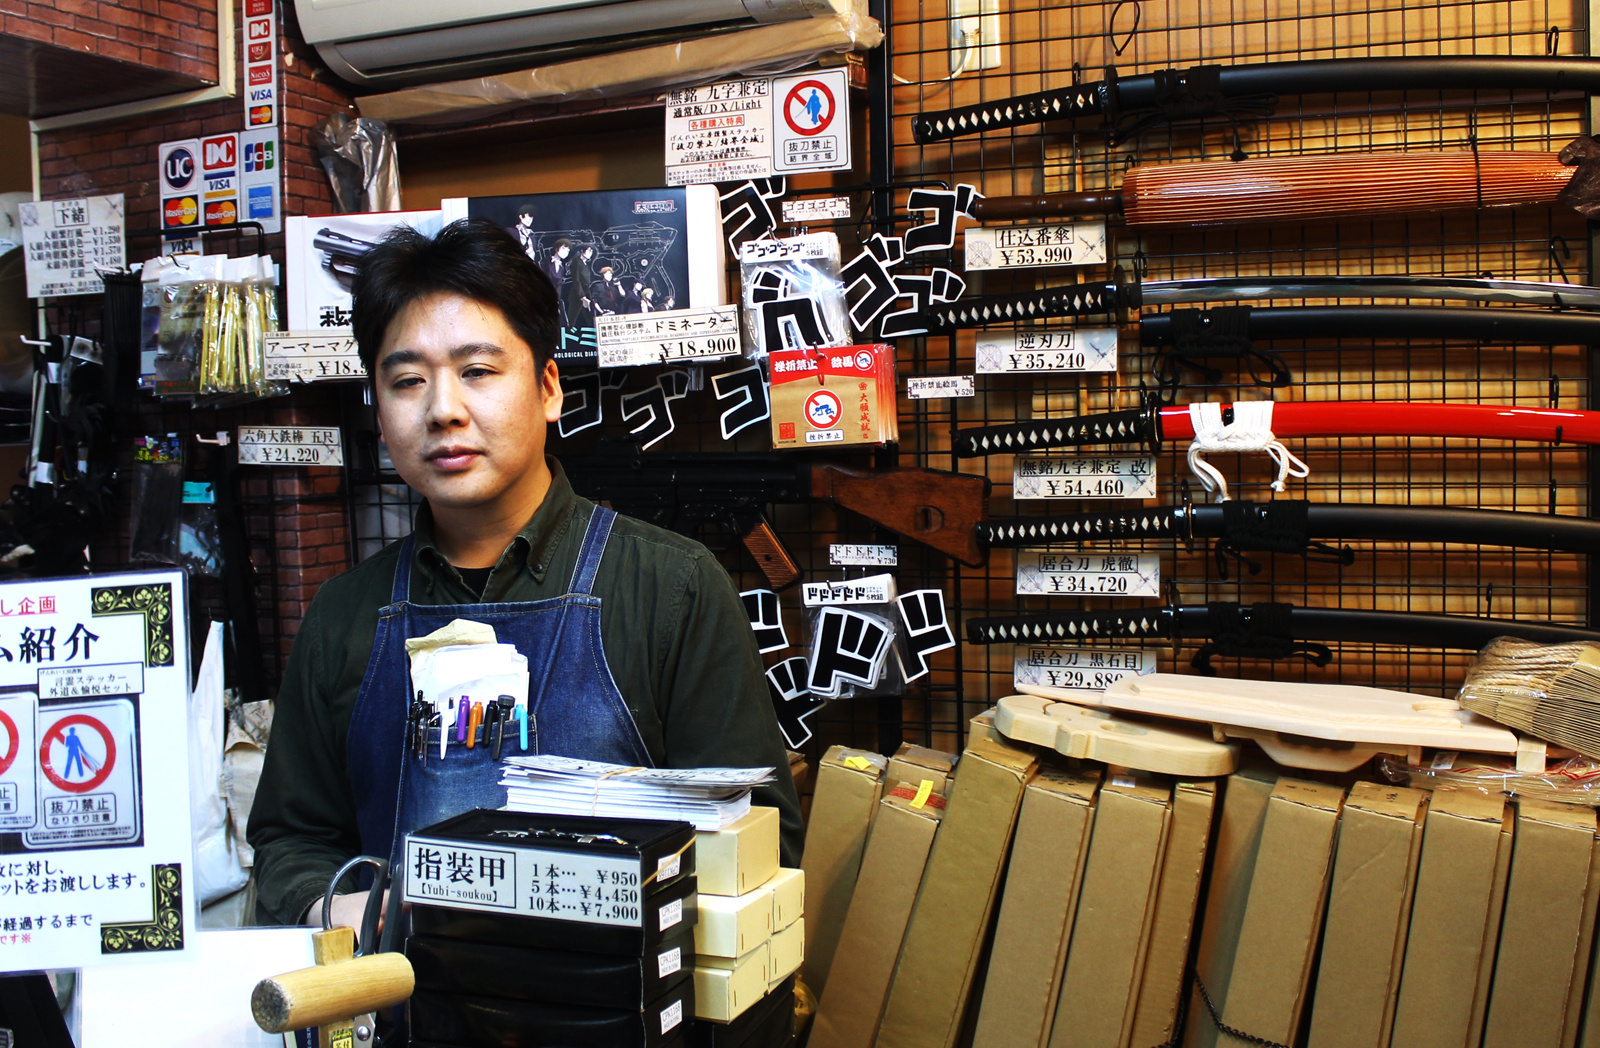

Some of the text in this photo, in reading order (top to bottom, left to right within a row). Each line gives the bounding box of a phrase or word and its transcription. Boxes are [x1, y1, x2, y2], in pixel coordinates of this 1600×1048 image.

[251, 21, 269, 37] DC
[250, 88, 272, 101] VISA
[670, 80, 766, 105] 無銘 九字兼定
[250, 111, 272, 119] MasterCard
[691, 116, 743, 130] 各種購入特典
[206, 140, 234, 166] DC
[789, 139, 832, 152] 抜刀禁止
[244, 149, 274, 163] JCB
[166, 156, 194, 179] UC
[209, 178, 231, 191] VISA
[57, 207, 85, 224] 下緒
[165, 206, 197, 219] MasterCard
[206, 209, 236, 221] MasterCard
[1000, 226, 1070, 246] 仕込番傘
[747, 242, 805, 257] ゴゴゴゴゴ
[1001, 246, 1073, 265] ¥53,990
[655, 316, 733, 333] ドミネーター
[660, 337, 736, 358] ¥18,900
[1019, 333, 1071, 349] 逆刃刀
[774, 358, 818, 373] 挫折禁止
[1009, 353, 1085, 370] ¥35,240
[912, 380, 957, 390] 挫折禁止絵馬
[955, 388, 974, 396] ¥520
[244, 430, 334, 444] 六角大鉄棒 五尺
[809, 432, 841, 441] 挫折禁止
[262, 448, 319, 463] ¥24,220
[1022, 459, 1147, 475] 無銘九字兼定 改
[1047, 480, 1124, 496] ¥54,460
[834, 545, 884, 556] ドドドドド
[1041, 556, 1135, 572] 居合刀 虎徹
[1050, 576, 1128, 594] ¥34,720
[808, 587, 866, 601] ドドドドド
[1030, 651, 1137, 668] 居合刀 黒石目
[55, 674, 127, 686] 言霊ステッカー
[51, 798, 110, 814] 抜刀禁止
[51, 813, 110, 825] なりきり注意
[415, 847, 505, 887] 指装甲
[597, 869, 637, 887] ¥950
[422, 882, 498, 903] 【Yubi-soukou】
[580, 885, 638, 904] ¥4,450
[581, 902, 638, 921] ¥7,900
[0, 914, 93, 932] 経過するまで
[660, 951, 680, 967] CPK1168
